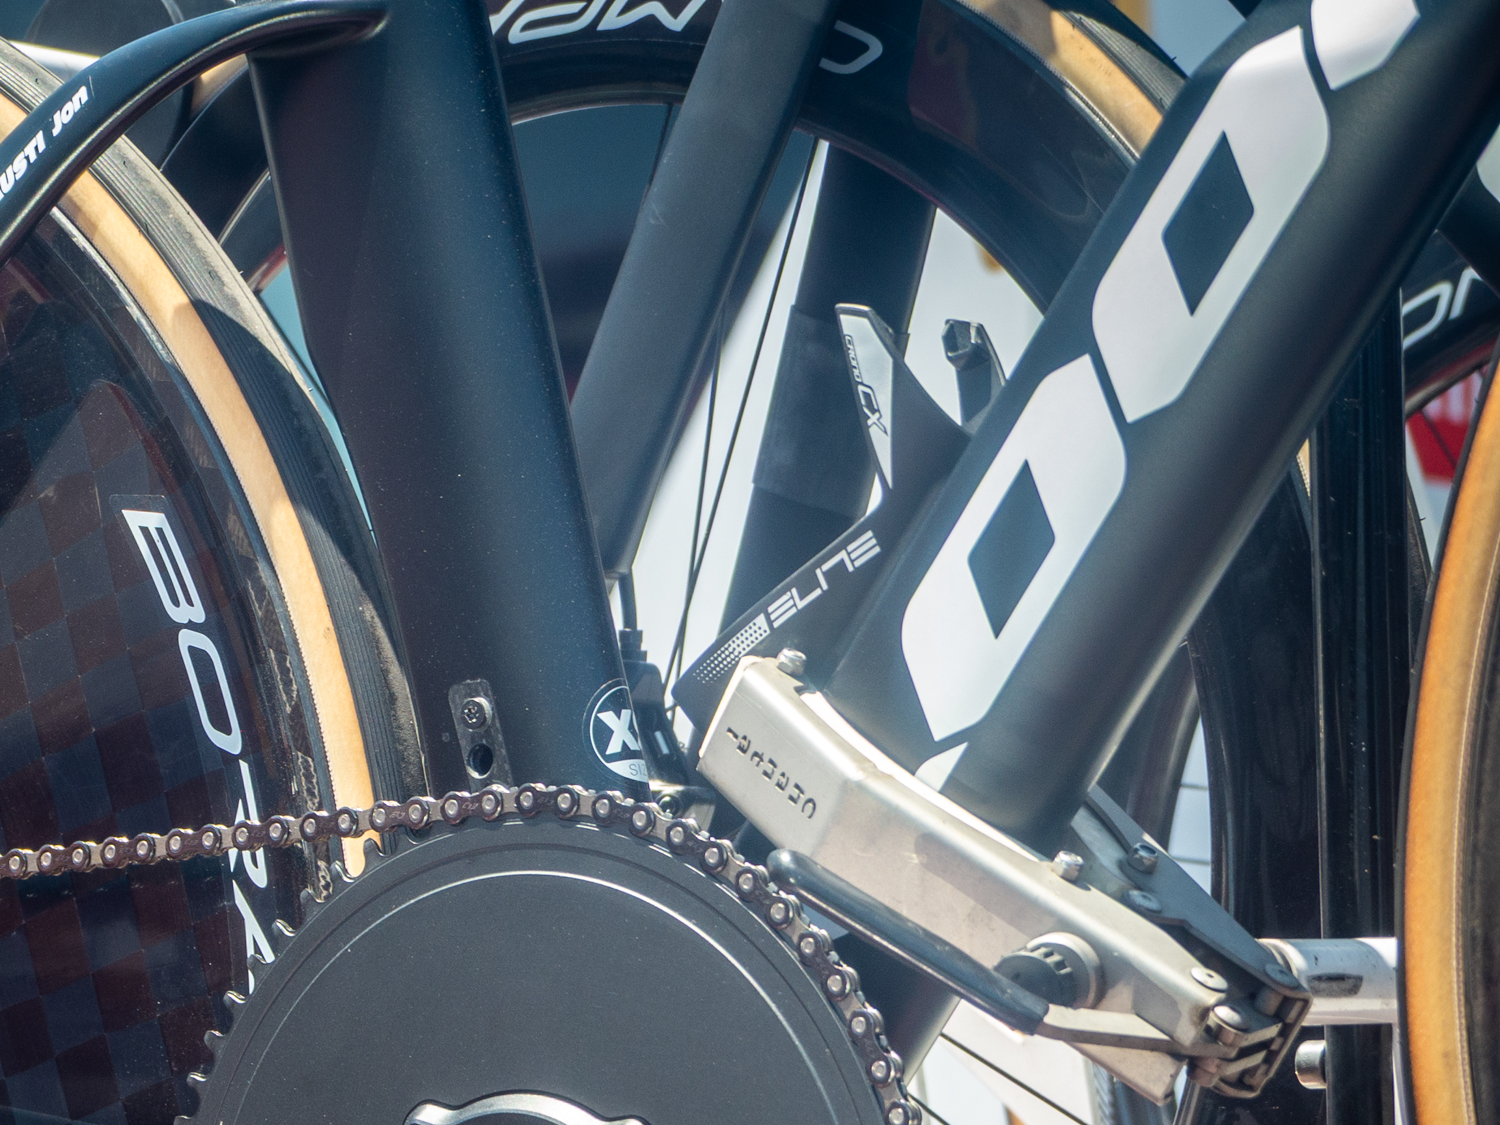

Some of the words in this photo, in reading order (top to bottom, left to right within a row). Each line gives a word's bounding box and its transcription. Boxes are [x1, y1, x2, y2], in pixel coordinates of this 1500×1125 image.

[51, 85, 88, 136] Jon
[843, 333, 862, 384] CRONO
[857, 383, 889, 437] CX
[767, 529, 881, 629] ELITE
